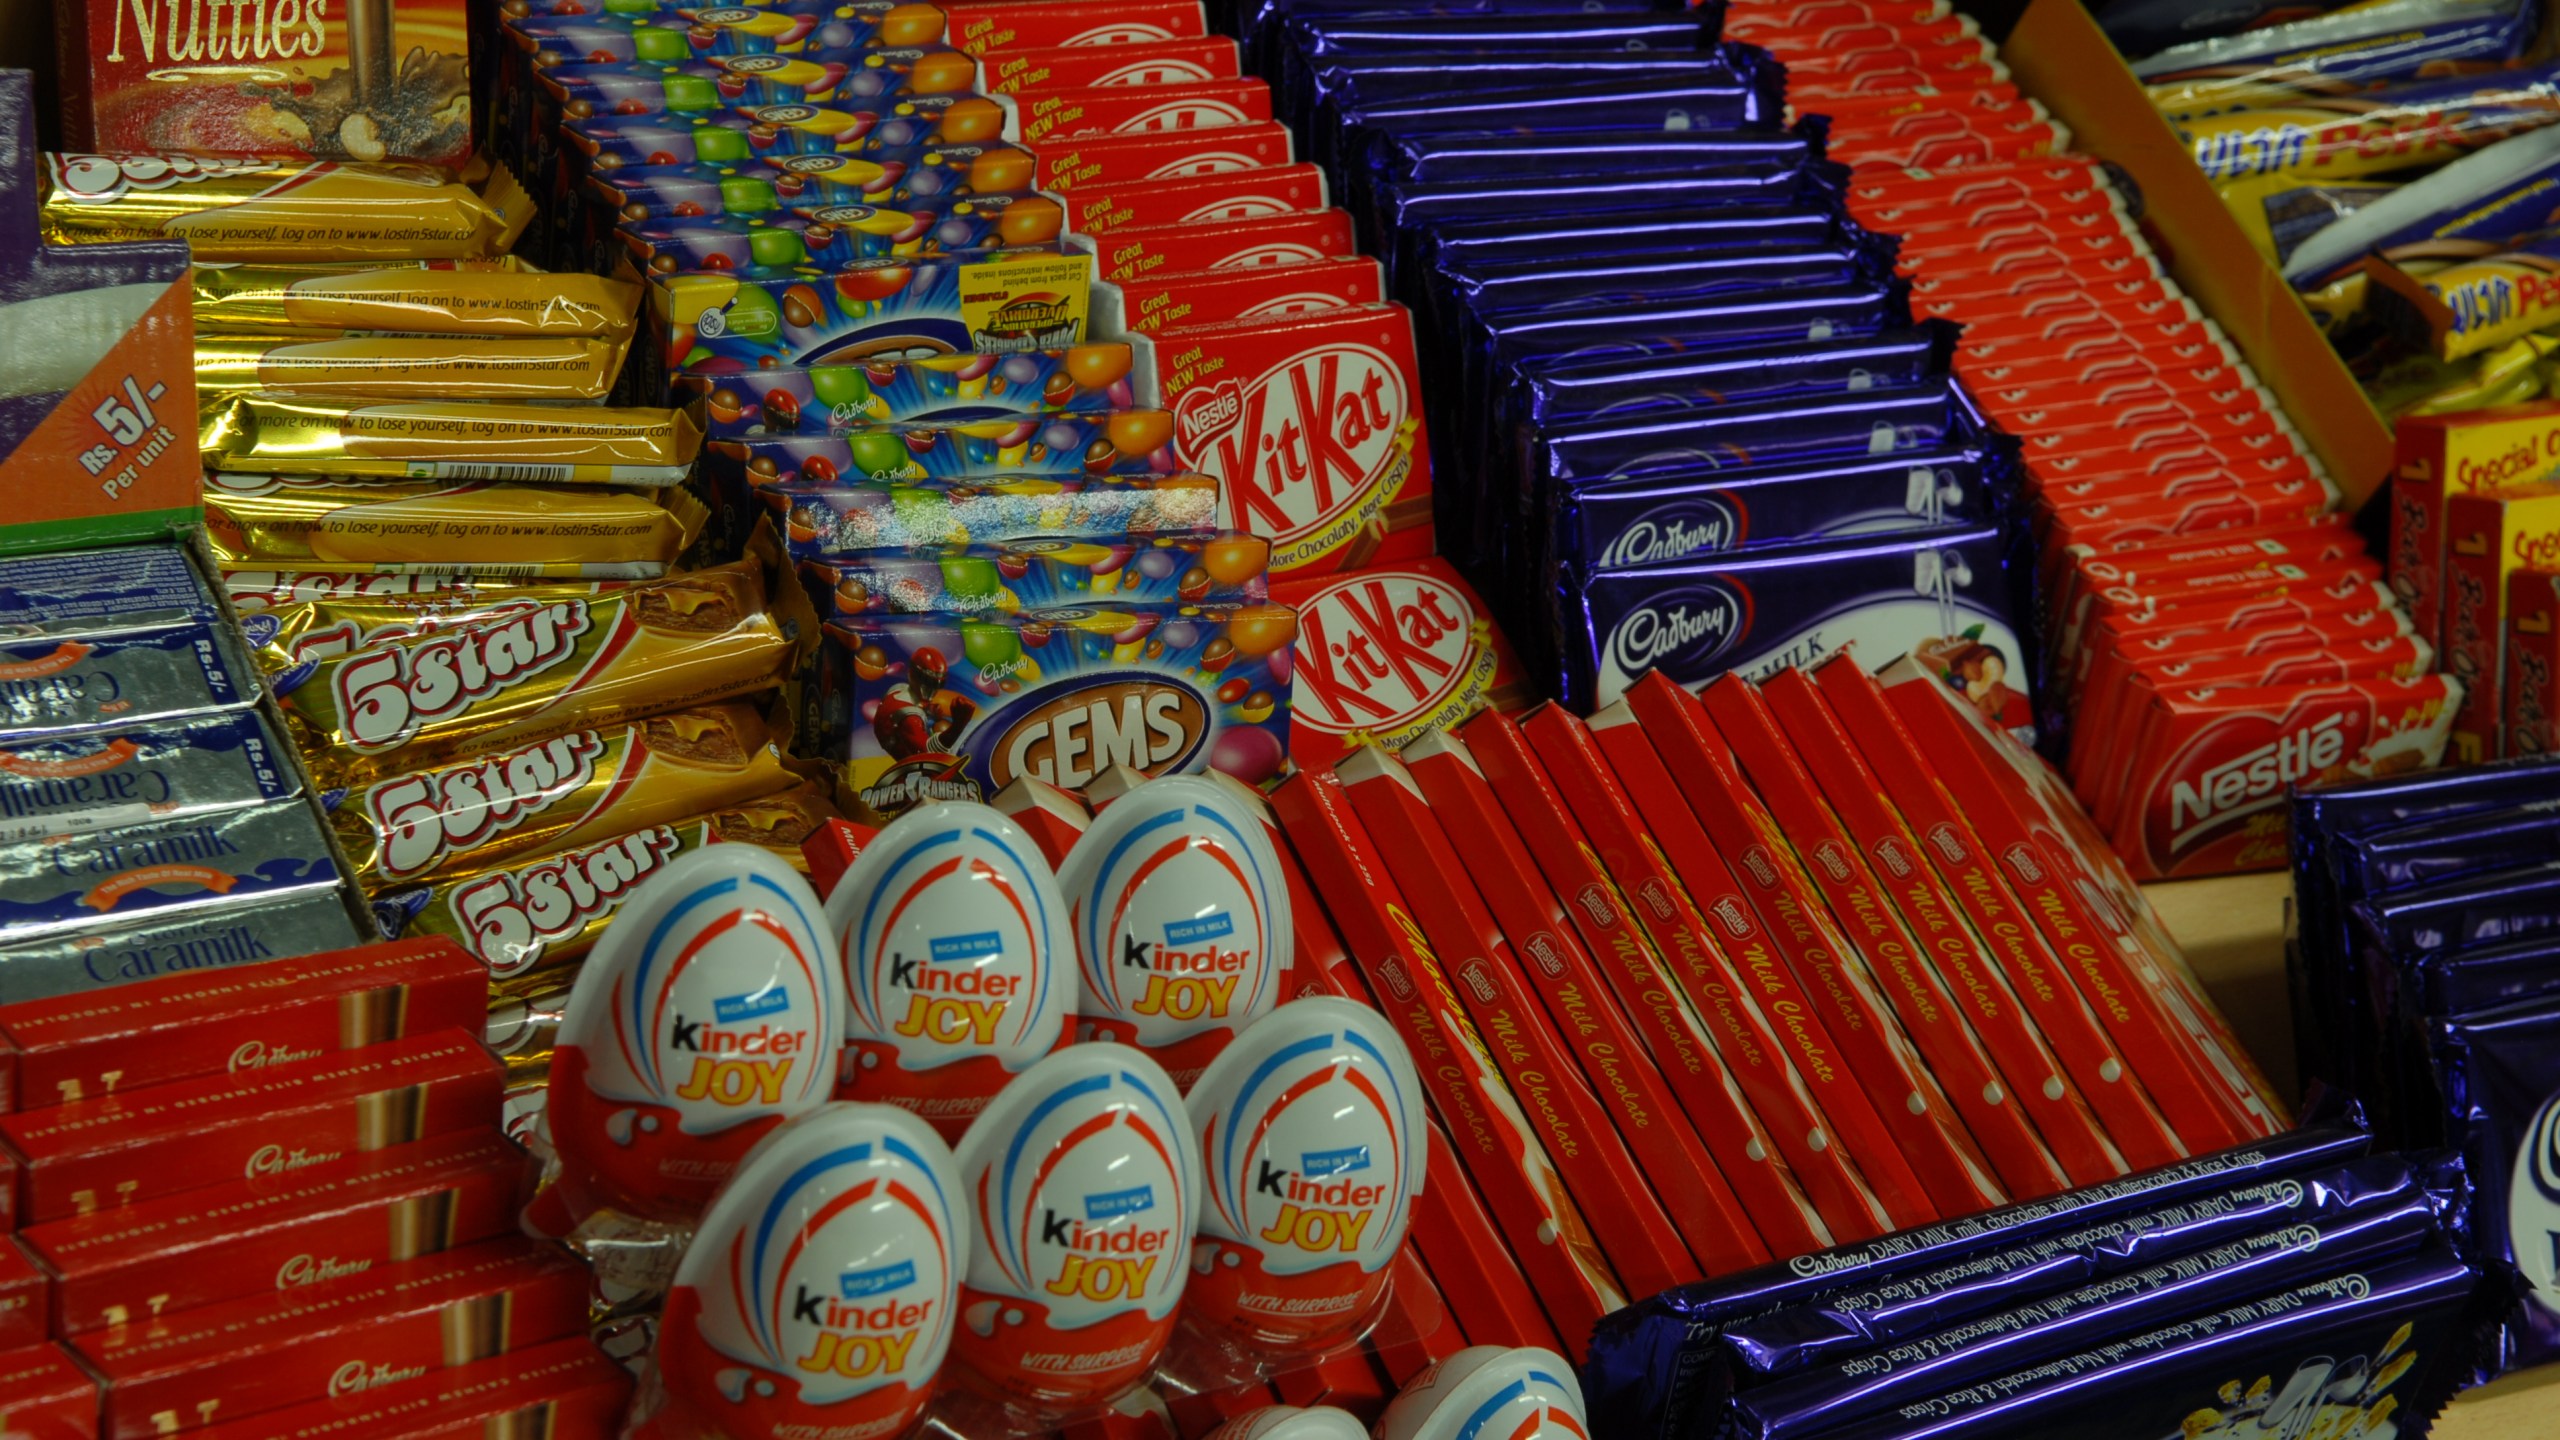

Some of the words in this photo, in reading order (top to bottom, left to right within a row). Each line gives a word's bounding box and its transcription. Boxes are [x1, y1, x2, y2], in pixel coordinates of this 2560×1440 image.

[107, 0, 326, 62] Nutties
[1025, 115, 1054, 143] NEW
[1055, 105, 1084, 125] Taste
[1033, 96, 1062, 117] Great
[115, 227, 133, 238] on
[137, 225, 168, 239] how
[172, 226, 186, 238] to
[190, 226, 218, 239] lose
[221, 226, 279, 241] yourself,
[282, 227, 303, 242] log
[306, 229, 324, 240] on
[327, 228, 343, 240] to
[1140, 291, 1170, 315] Great
[1165, 302, 1192, 322] Taste
[1165, 368, 1195, 398] NEW
[1198, 355, 1225, 377] Taste
[1172, 346, 1203, 371] Great
[92, 374, 169, 447] 5/-
[831, 396, 879, 425] Cadbury
[78, 442, 119, 477] Rs.
[101, 463, 139, 501] Per
[136, 425, 177, 468] unit
[1215, 354, 1392, 533] KitKat
[227, 519, 266, 532] more
[269, 520, 288, 532] on
[292, 519, 326, 533] how
[329, 520, 345, 533] to
[348, 520, 378, 534] lose
[378, 520, 441, 537] yourself,
[444, 523, 467, 538] log
[470, 524, 490, 536] on
[493, 524, 508, 535] to
[511, 522, 652, 537] www.lostin5star.com
[1268, 550, 1296, 569] More
[1297, 516, 1360, 559] Chocolaty,
[1359, 493, 1383, 523] More
[1380, 453, 1410, 495] Crispy
[1614, 519, 1720, 564] Cadbury
[1295, 581, 1460, 725] KitKat
[1618, 606, 1726, 668] Cadbury
[1760, 633, 1827, 679] MILK
[979, 656, 1029, 685] Cadbury
[1008, 692, 1186, 789] GEMS
[245, 737, 276, 793] Rs.5/-
[2171, 713, 2344, 832] Nestlé
[1170, 927, 1194, 940] RICH
[1196, 925, 1206, 936] IN
[1207, 918, 1230, 934] MILK
[1962, 865, 2004, 918] Milk
[1992, 921, 2056, 1004] Chocolate
[84, 924, 273, 983] Caramilk
[1124, 933, 1251, 974] kinder
[1848, 884, 1883, 938] Milk
[1877, 940, 1939, 1024] Chocolate
[2037, 887, 2080, 940] Milk
[2066, 942, 2132, 1024] Chocolate
[889, 952, 1022, 997] kinder
[1132, 975, 1240, 1021] JOY
[1611, 929, 1654, 986] Milk
[1641, 988, 1702, 1076] Chocolate
[1743, 941, 1786, 996] Milk
[1772, 999, 1835, 1084] Chocolate
[670, 1014, 808, 1055] kinder
[895, 993, 1006, 1045] JOY
[1558, 981, 1593, 1037] Milk
[1588, 1042, 1651, 1130] Chocolate
[676, 1056, 795, 1106] JOY
[1490, 1007, 1524, 1066] Milk
[1519, 1069, 1579, 1160] Chocolate
[1256, 1160, 1386, 1207] kinder
[2231, 1179, 2304, 1209] Cadbury
[1789, 1248, 1873, 1278] Cadbury
[1870, 1234, 1918, 1262] DAIRY
[1918, 1224, 1953, 1252] MILK
[1956, 1217, 1985, 1240] milk
[1985, 1202, 2052, 1234] chocolate
[2104, 1165, 2182, 1206] Butterscotch
[2182, 1164, 2197, 1181] &
[2196, 1157, 2226, 1178] Rice
[2224, 1149, 2267, 1174] Crisps
[2127, 1217, 2153, 1238] milk
[2154, 1206, 2189, 1231] MILK
[2191, 1198, 2235, 1221] DAIRY
[1041, 1209, 1169, 1253] kinder
[1261, 1209, 1372, 1252] JOY
[2037, 1240, 2061, 1257] with
[2061, 1222, 2125, 1253] chocolate
[1045, 1255, 1159, 1301] JOY
[1926, 1253, 2009, 1292] Butterscotch
[2009, 1248, 2036, 1267] Nut
[1834, 1292, 1884, 1316] Crisps
[1880, 1281, 1913, 1302] Rice
[1912, 1277, 1926, 1295] &
[2260, 1289, 2302, 1312] DAIRY
[2296, 1273, 2371, 1300] Cadbury
[793, 1285, 933, 1331] kinder
[2197, 1313, 2223, 1335] milk
[2224, 1301, 2260, 1326] MILK
[797, 1330, 917, 1378] JOY
[2104, 1341, 2131, 1362] with
[2131, 1323, 2194, 1350] chocolate
[1994, 1358, 2076, 1395] Butterscotch
[2074, 1347, 2105, 1371] Nut
[1898, 1395, 1950, 1420] Crisps
[1945, 1386, 1983, 1407] Rice
[1979, 1383, 1995, 1400] &
